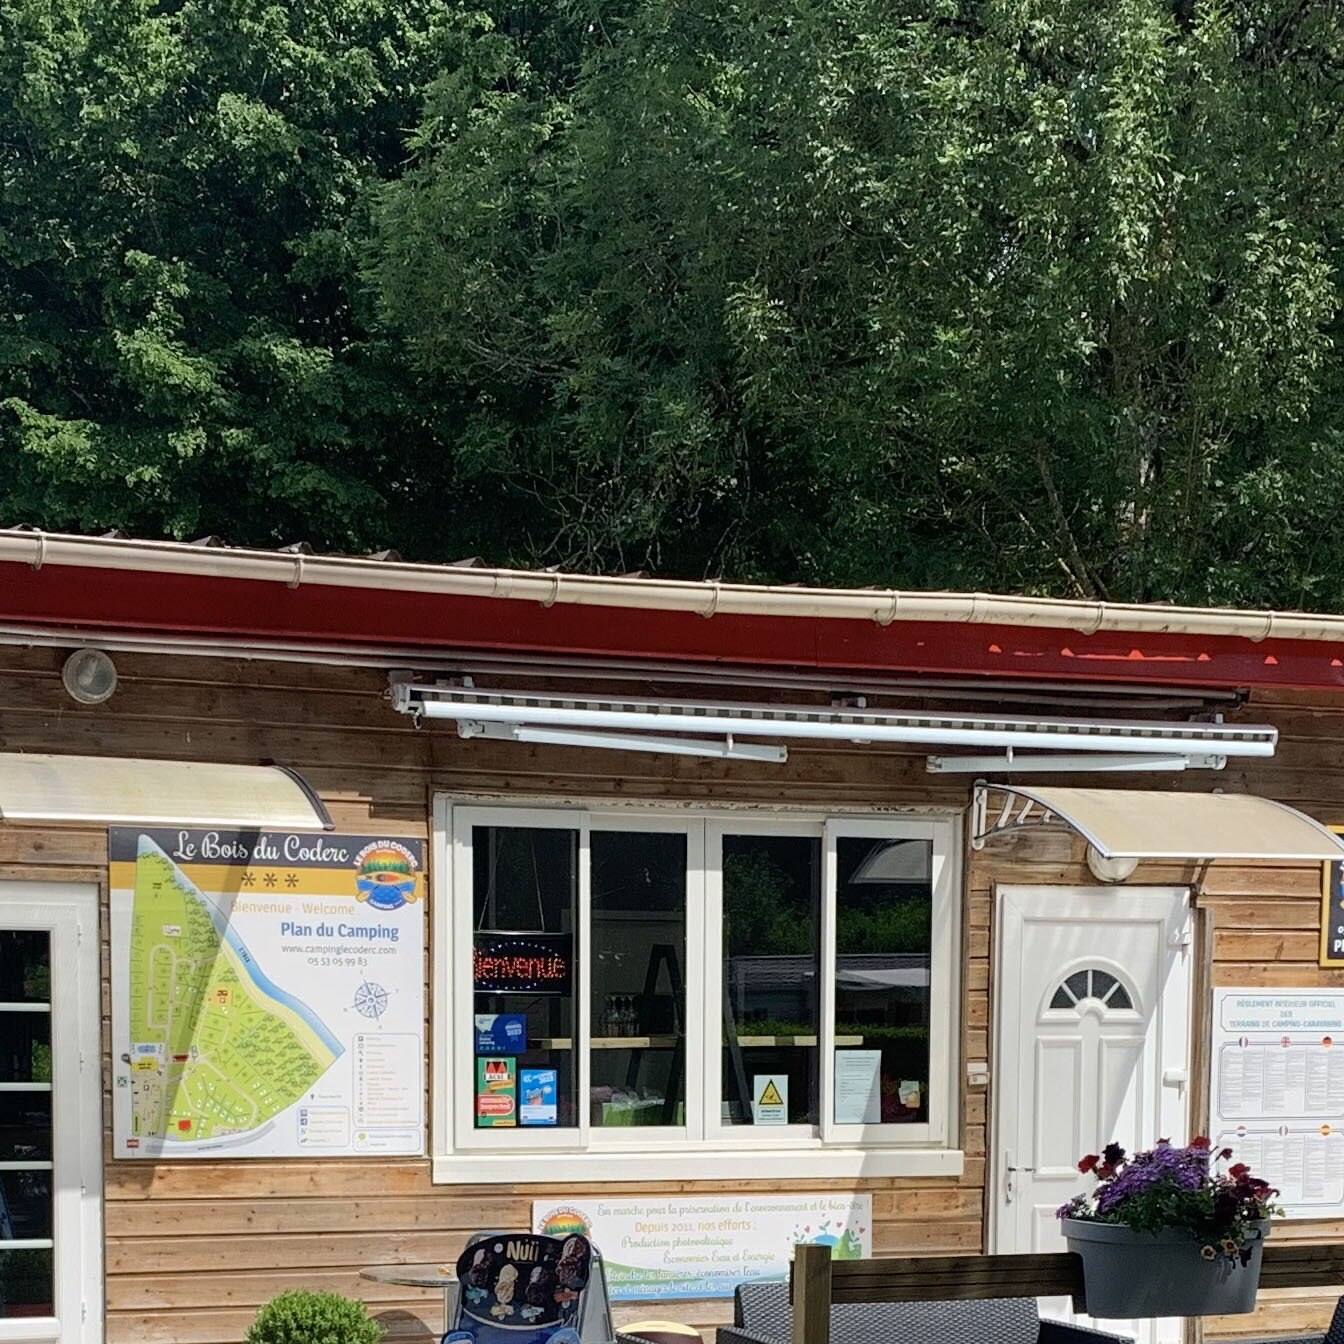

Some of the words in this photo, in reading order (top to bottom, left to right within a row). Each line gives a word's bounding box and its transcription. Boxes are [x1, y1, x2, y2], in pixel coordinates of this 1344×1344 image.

[173, 831, 197, 860] Le
[199, 832, 248, 859] Bois
[254, 833, 280, 860] du
[284, 835, 349, 862] Coderc
[359, 842, 378, 858] BOIS
[377, 840, 391, 849] DU
[390, 841, 419, 868] CODERC
[231, 901, 292, 914] Bienvenue
[303, 903, 355, 915] Welcome
[281, 922, 312, 937] Plan
[317, 924, 335, 938] du
[338, 925, 399, 942] Camping
[308, 958, 318, 966] 05
[320, 958, 331, 967] 53
[332, 958, 343, 966] 05
[345, 958, 356, 967] 99
[357, 957, 368, 967] 83
[474, 952, 566, 979] ienvenue
[635, 1222, 669, 1233] Depuis
[698, 1222, 716, 1231] nos
[718, 1219, 751, 1231] efforts
